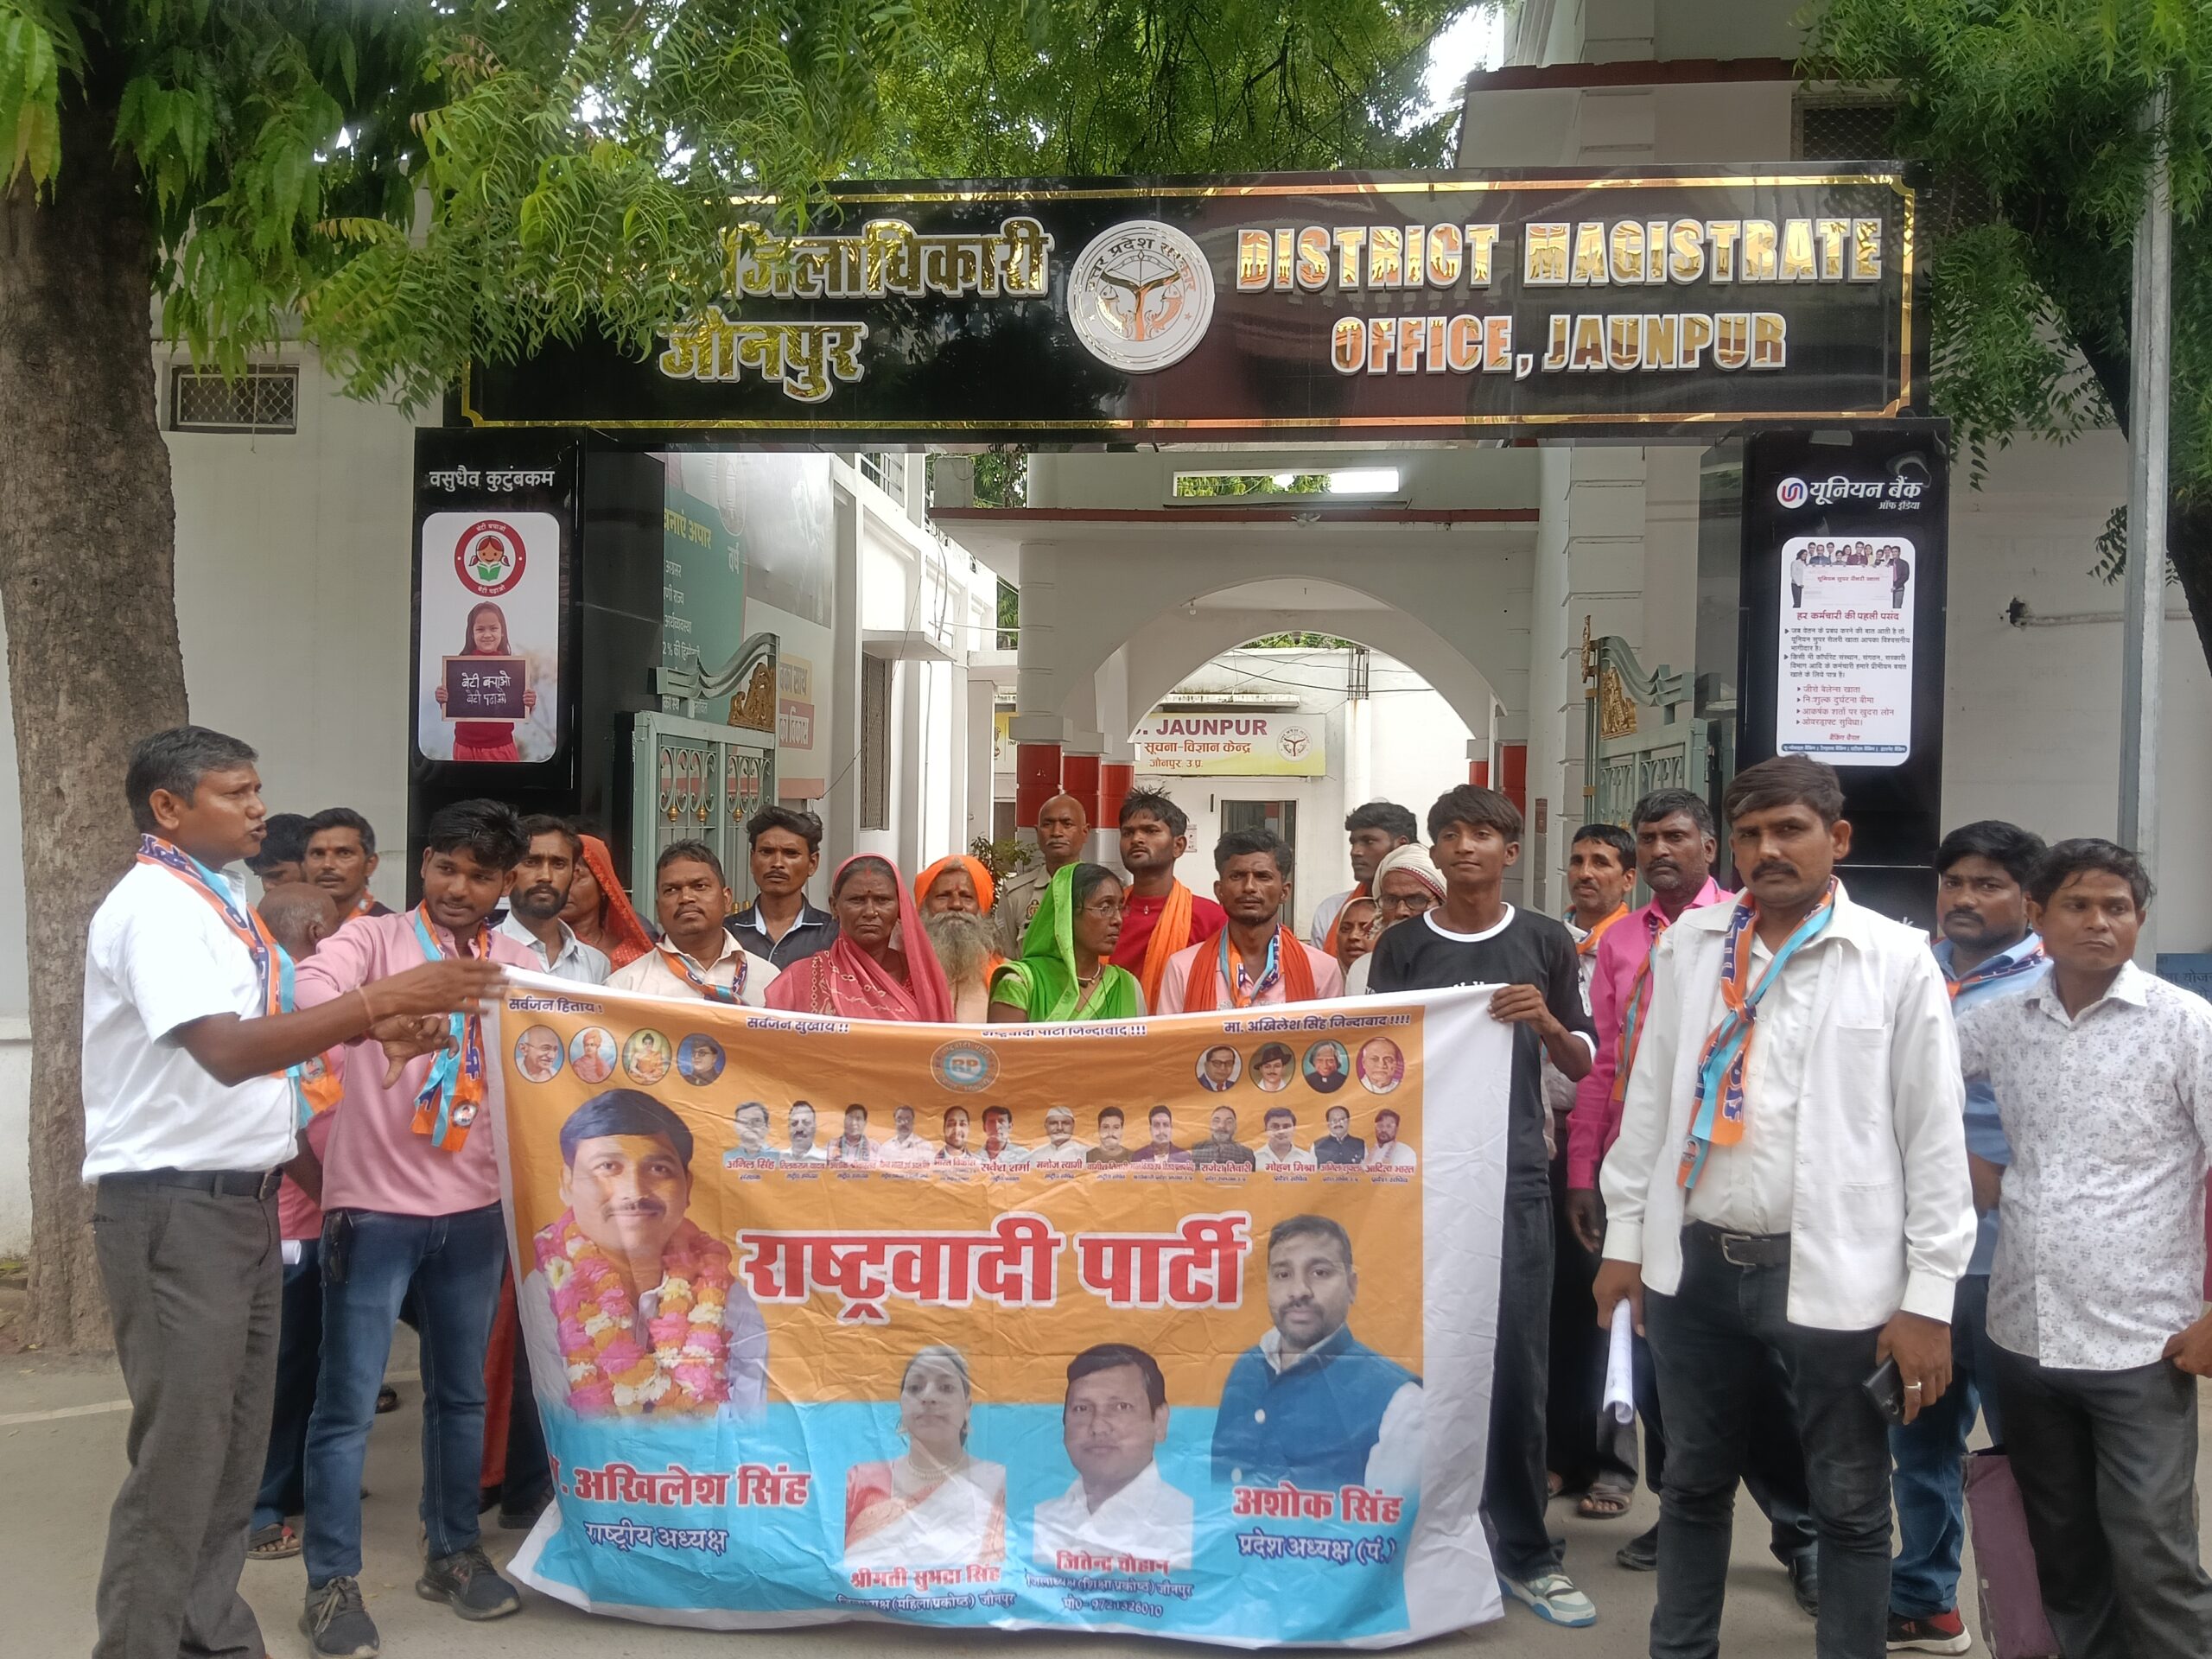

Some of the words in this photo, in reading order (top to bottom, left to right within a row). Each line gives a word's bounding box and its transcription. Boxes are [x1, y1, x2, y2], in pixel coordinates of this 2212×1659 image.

[719, 217, 1054, 299] जिलाधिकारी
[1085, 256, 1109, 292] उत्तर
[1108, 237, 1155, 257] प्रदेश
[1236, 221, 1499, 293] DISTRICT
[1522, 217, 1883, 287] MAGISTRATE
[1330, 314, 1532, 381] OFFICE,
[1541, 311, 1787, 373] JAUNPUR
[429, 465, 480, 493] वसुधैव
[486, 465, 556, 493] कुटुंबकम
[1809, 475, 1885, 505] यूनियन
[1888, 475, 1923, 499] बैंक
[1878, 500, 1896, 510] ऑफ
[688, 519, 712, 550] अपार
[728, 542, 740, 575] वर्ष
[1796, 611, 1808, 620] हर
[1810, 609, 1842, 620] कर्मचारी
[1845, 609, 1856, 620] की
[1857, 610, 1878, 620] पहली
[1880, 610, 1899, 620] पसंद
[461, 672, 479, 688] बेटी
[465, 689, 481, 704] बेटी
[1156, 719, 1268, 735] JAUNPUR
[1144, 739, 1220, 754] सूचना-विज्ञान
[1223, 740, 1252, 753] केन्द्र
[508, 995, 554, 1011] सर्वजन
[556, 996, 595, 1014] हिताय
[747, 1016, 791, 1031] सर्वजन
[795, 1019, 835, 1034] सुखाय
[1224, 1020, 1244, 1033] मा.
[1248, 1016, 1302, 1032] अखिलेश
[1303, 1014, 1327, 1030] सिंह
[1330, 1014, 1388, 1028] जिन्दाबाद
[727, 1158, 754, 1169] अनिल
[757, 1158, 775, 1170] सिंह
[1008, 1160, 1031, 1173] शर्मा
[1036, 1159, 1059, 1169] मनोज
[1061, 1159, 1083, 1169] त्यागी
[1226, 1160, 1252, 1172] तिवारी
[1265, 1160, 1290, 1173] मोहन
[1294, 1160, 1315, 1172] मिश्रा
[741, 1217, 1062, 1319] राष्ट्रवादी
[1078, 1215, 1247, 1303] पार्टी
[574, 1464, 730, 1505] अखिलेश
[737, 1464, 811, 1505] सिंह
[1232, 1480, 1334, 1519] अशोक
[1339, 1484, 1404, 1523] सिंह
[584, 1518, 654, 1550] राष्ट्रीय
[658, 1527, 728, 1554] अध्यक्ष
[1236, 1526, 1286, 1557] प्रदेश
[1287, 1535, 1352, 1563] अध्यक्ष
[1056, 1550, 1114, 1573] जितेन्द्र
[1116, 1553, 1170, 1575] चौहान
[850, 1566, 907, 1588] श्रीमती
[966, 1564, 1001, 1584] सिंह
[978, 1590, 1016, 1607] जौनपुर
[1157, 1580, 1194, 1599] जौनपुर
